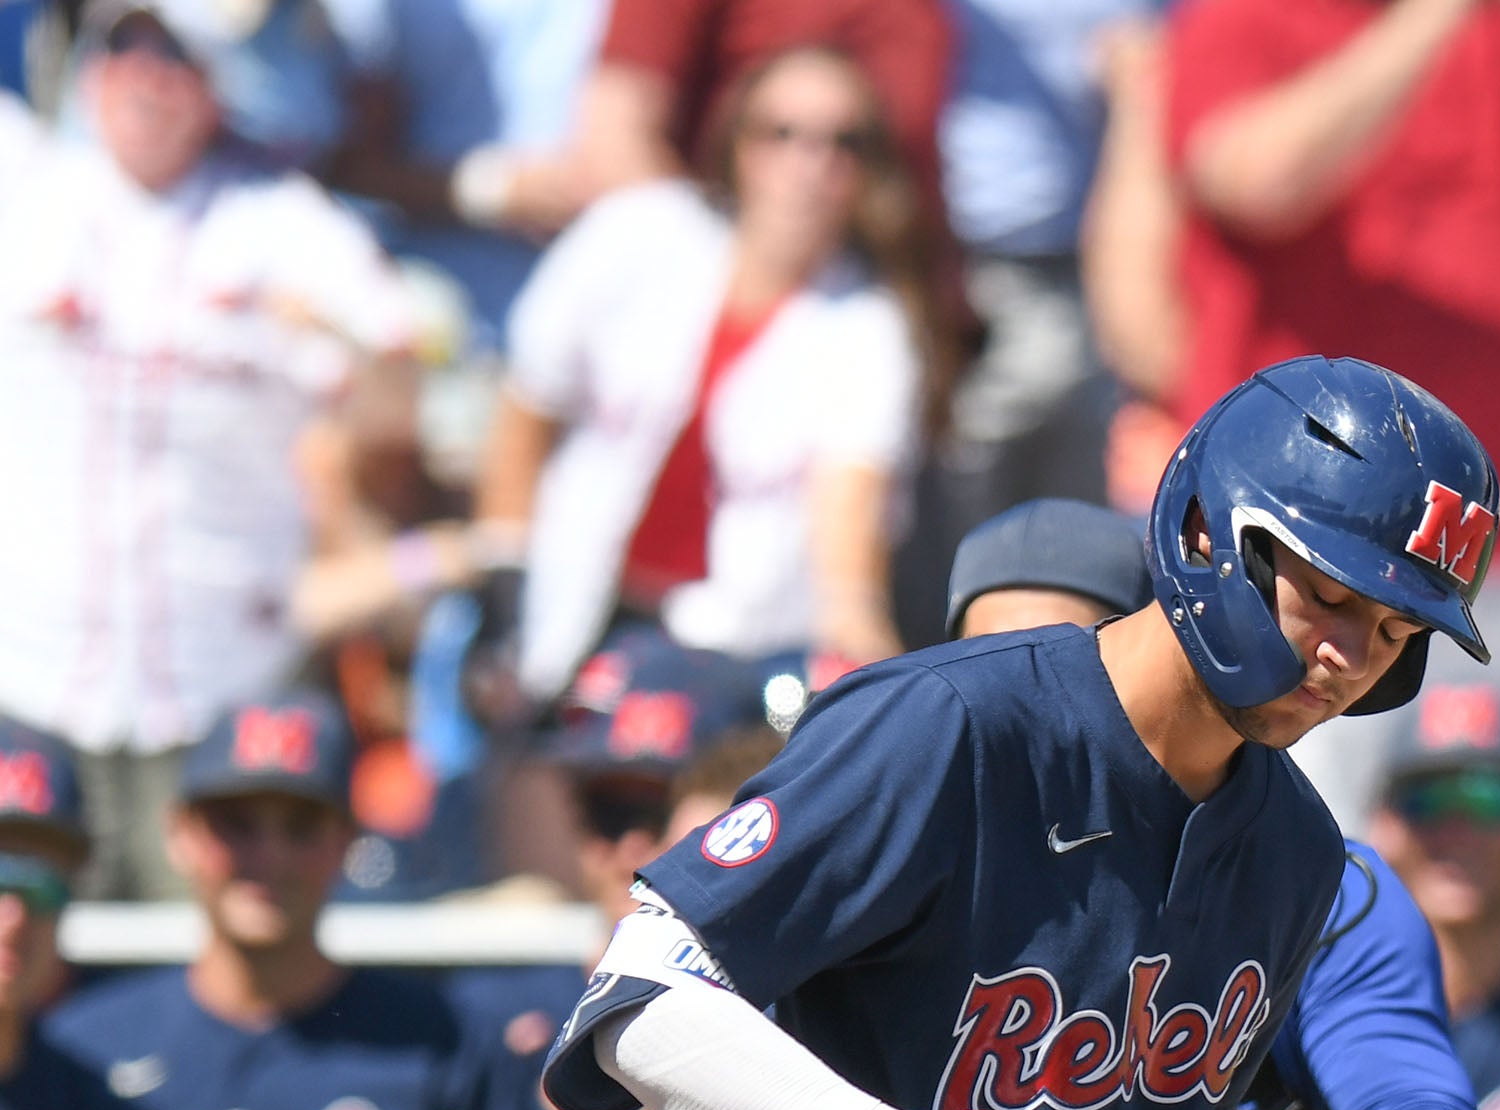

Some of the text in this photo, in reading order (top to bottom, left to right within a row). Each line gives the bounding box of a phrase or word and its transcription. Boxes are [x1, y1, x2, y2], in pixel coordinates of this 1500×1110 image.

[1270, 521, 1299, 548] EASTON
[1405, 479, 1495, 586] M
[705, 800, 776, 864] SEC
